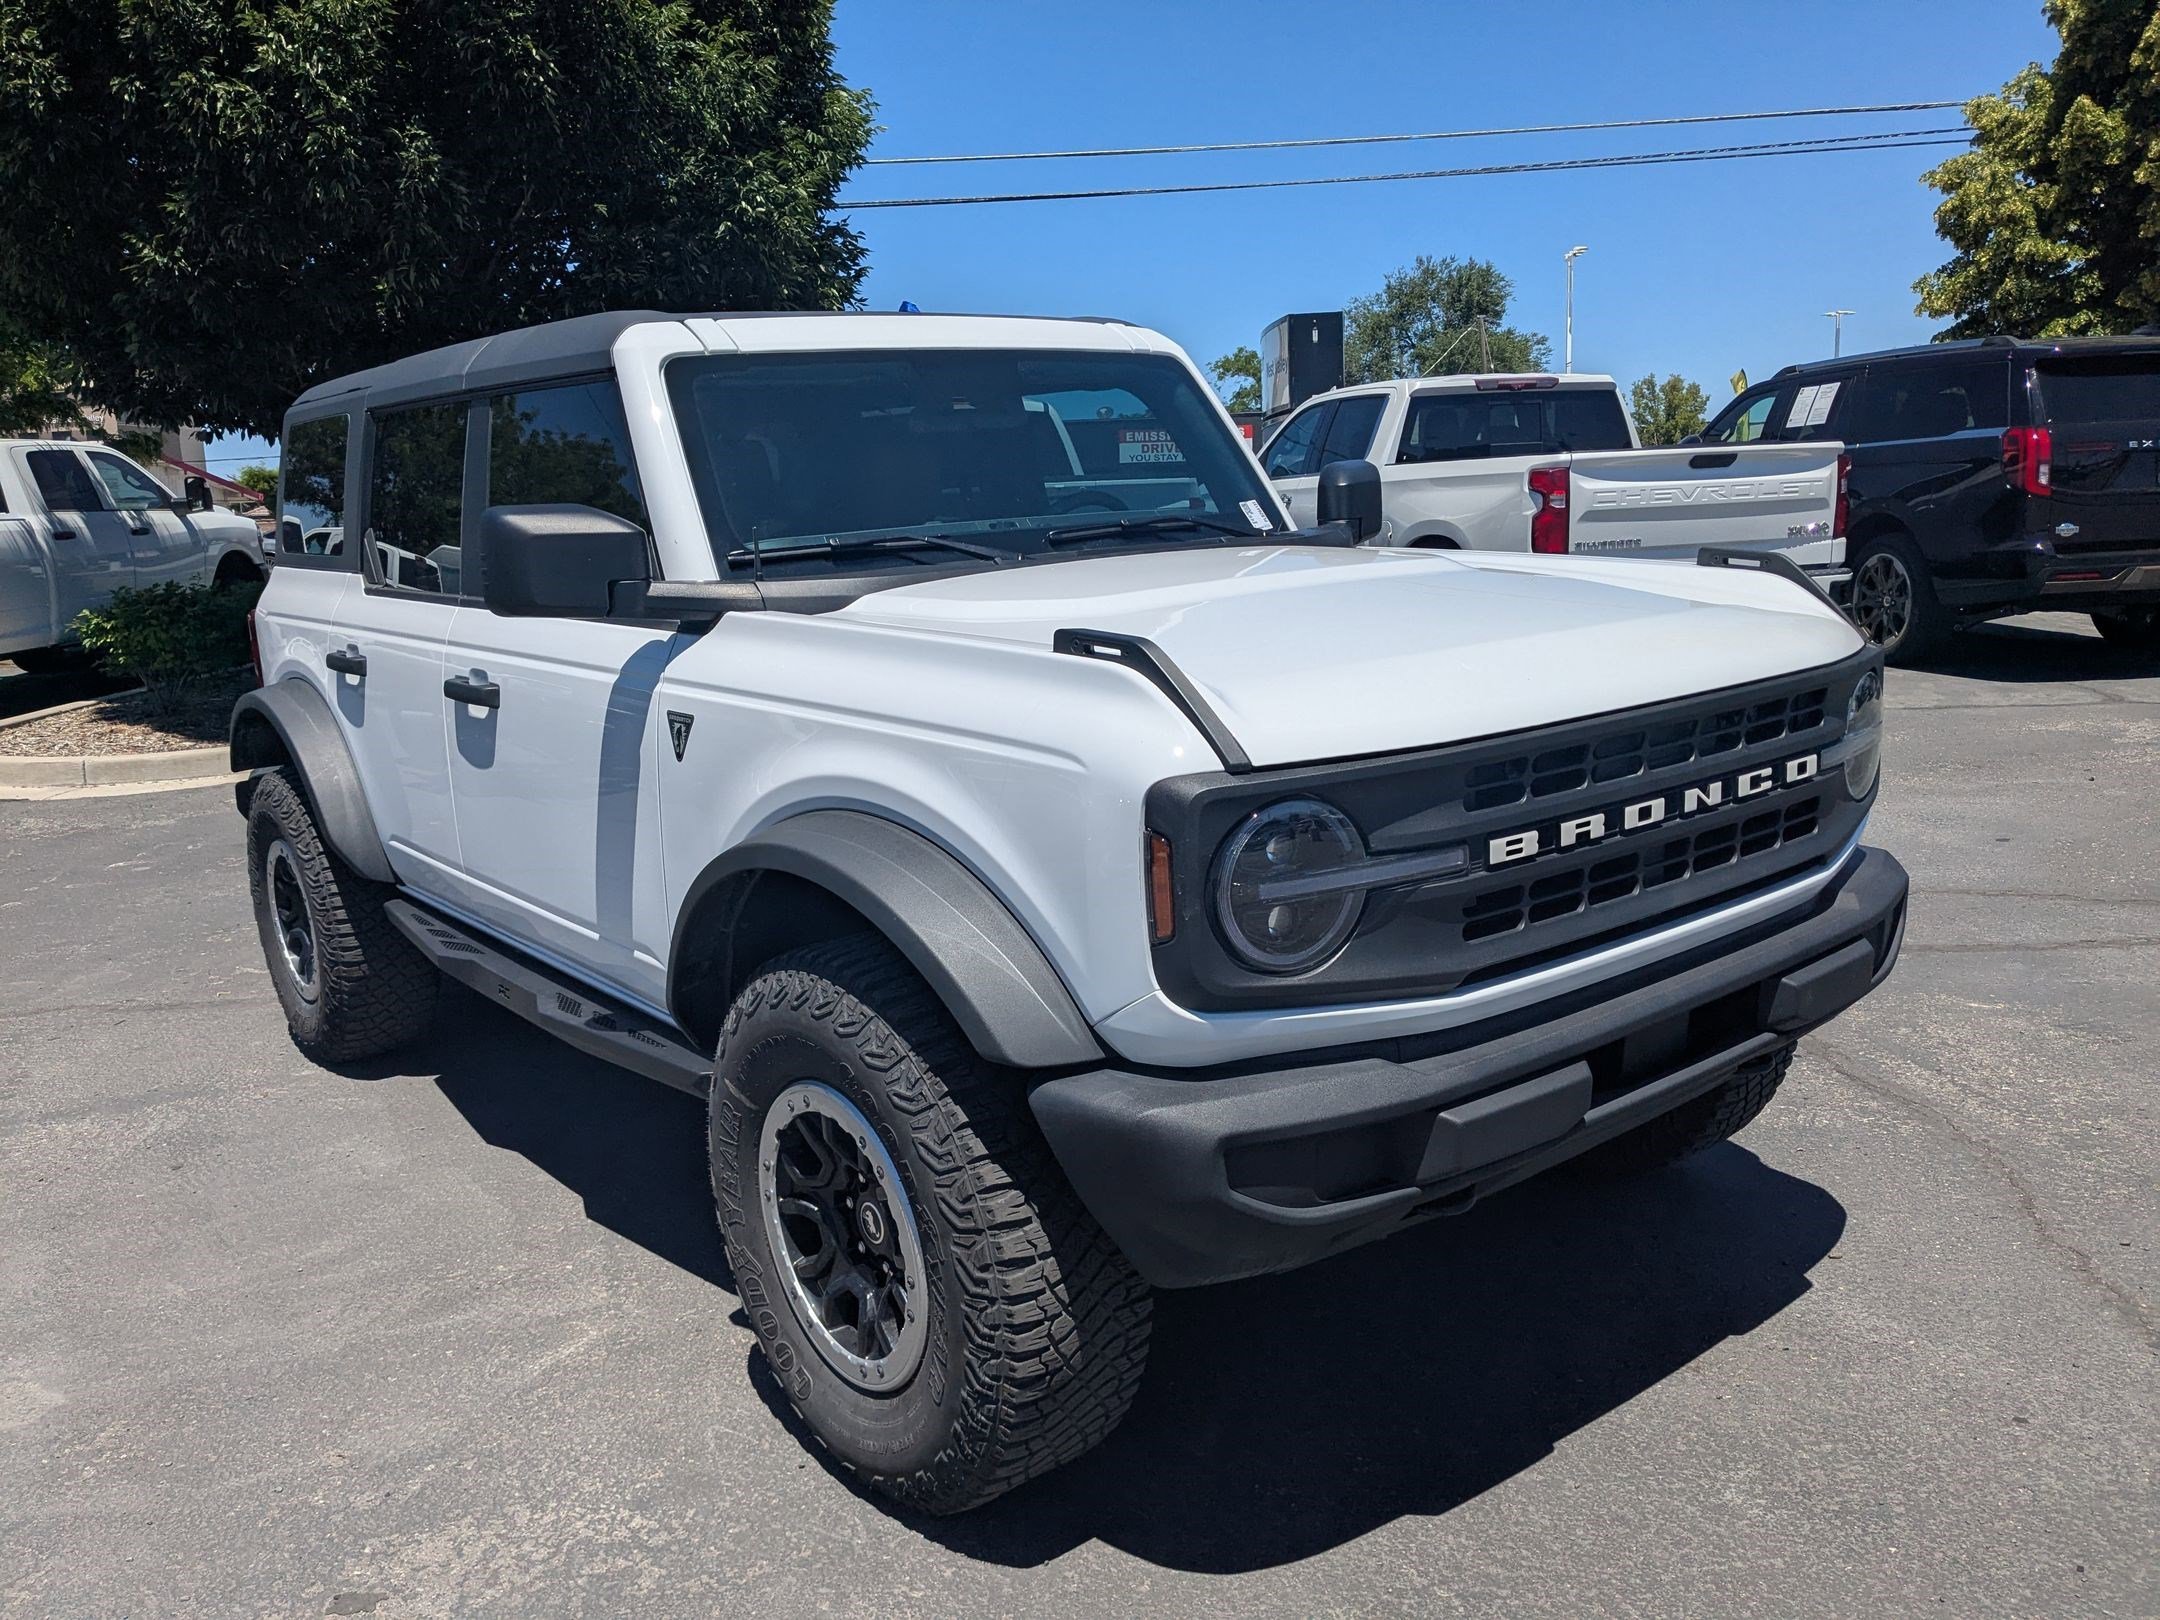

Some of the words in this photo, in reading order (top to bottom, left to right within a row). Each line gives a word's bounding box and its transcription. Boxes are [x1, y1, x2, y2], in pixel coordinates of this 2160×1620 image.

[2128, 439, 2160, 448] EX
[1129, 454, 1151, 462] YOU
[1154, 453, 1179, 462] STAY
[1592, 479, 1824, 508] CHEVROLET
[1488, 753, 1820, 866] BRONCO
